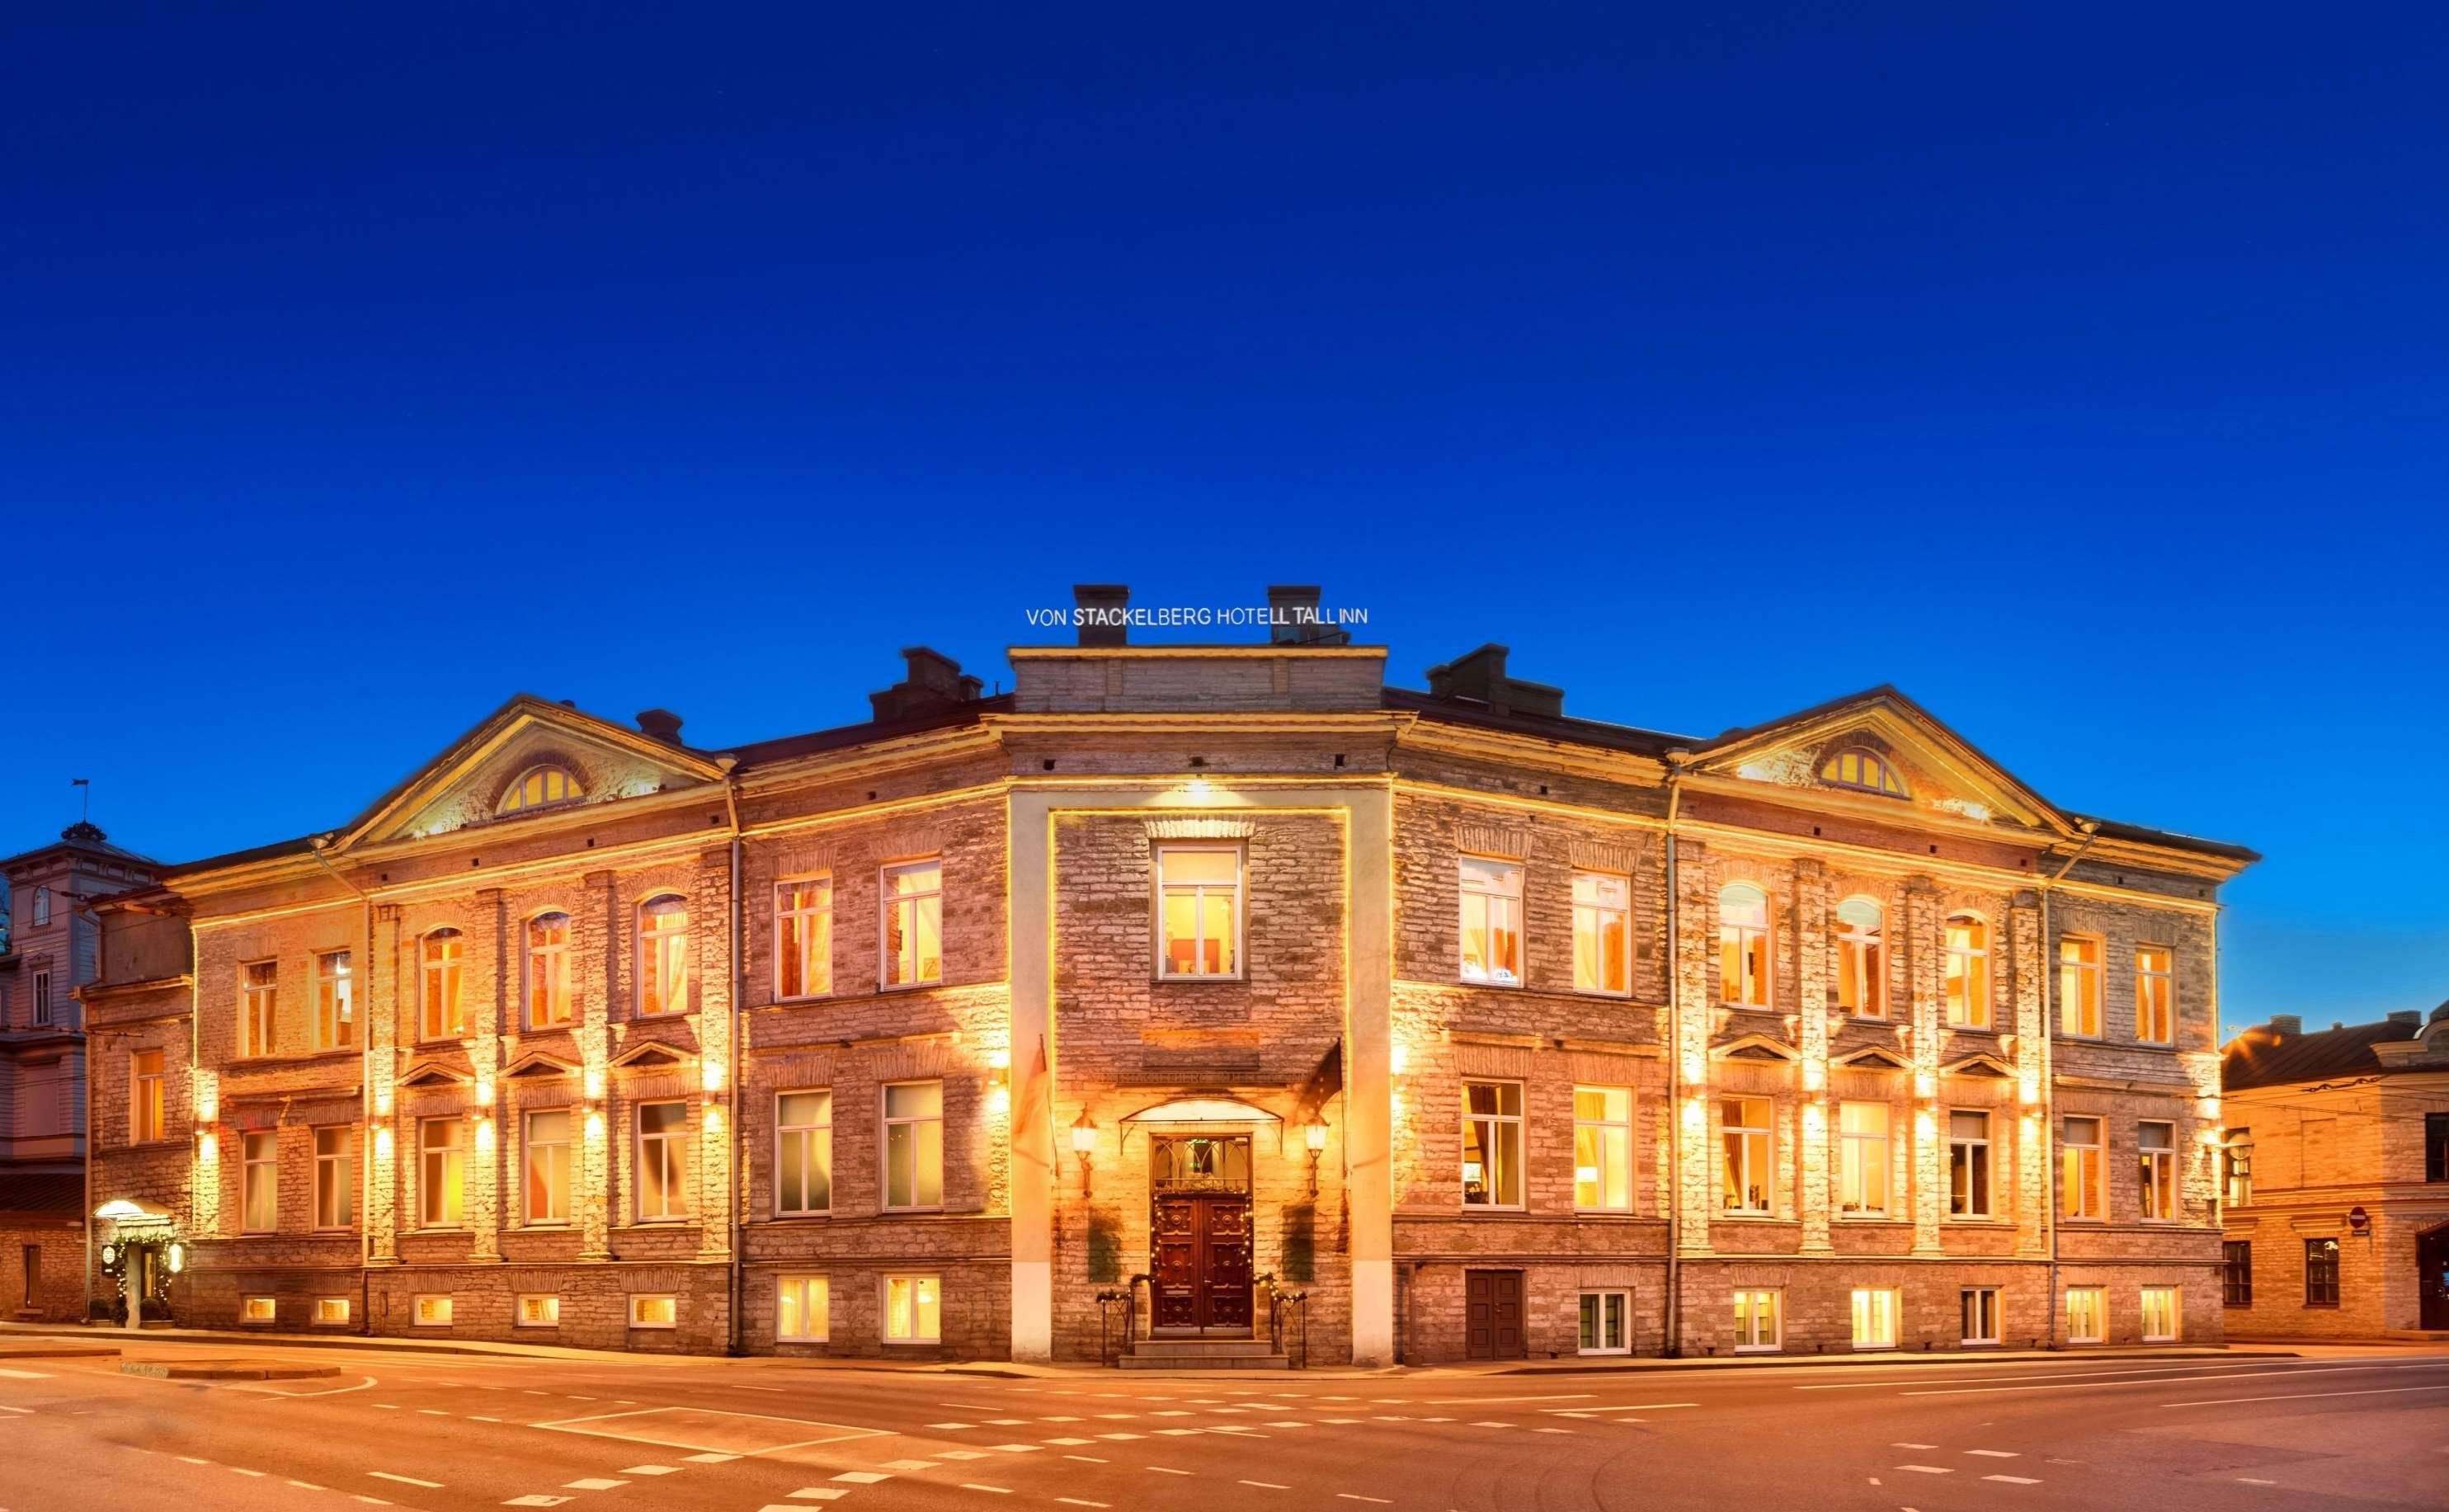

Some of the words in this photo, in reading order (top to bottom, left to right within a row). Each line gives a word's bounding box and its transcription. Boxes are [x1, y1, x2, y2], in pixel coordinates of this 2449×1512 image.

[1026, 609, 1067, 626] VON
[1072, 607, 1211, 626] STACKELBERG
[1217, 607, 1290, 624] HOTELL
[1293, 607, 1368, 624] TALLINN
